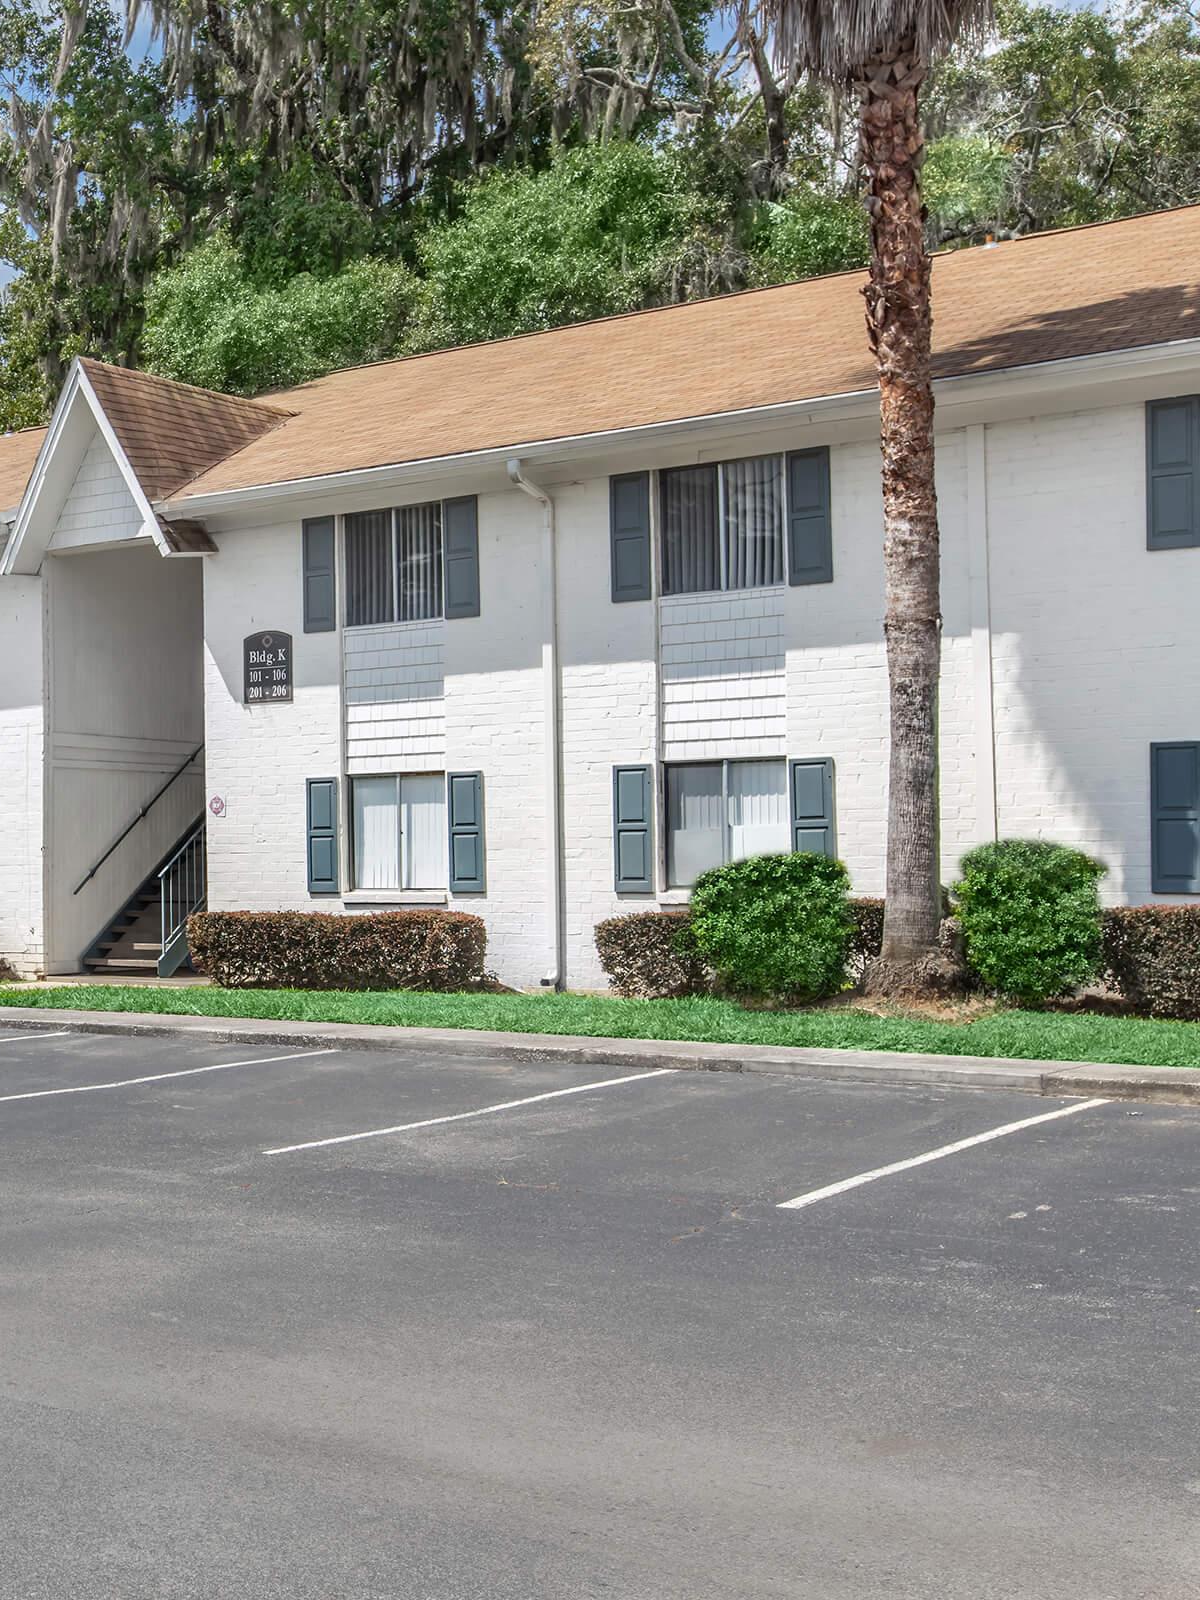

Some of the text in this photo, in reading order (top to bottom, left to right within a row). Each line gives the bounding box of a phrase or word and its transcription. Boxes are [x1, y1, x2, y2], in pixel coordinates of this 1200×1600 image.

[249, 648, 286, 666] Bldg. K
[249, 670, 262, 682] 101
[272, 668, 287, 681] 106
[249, 686, 263, 698] 201
[272, 684, 287, 697] 206
